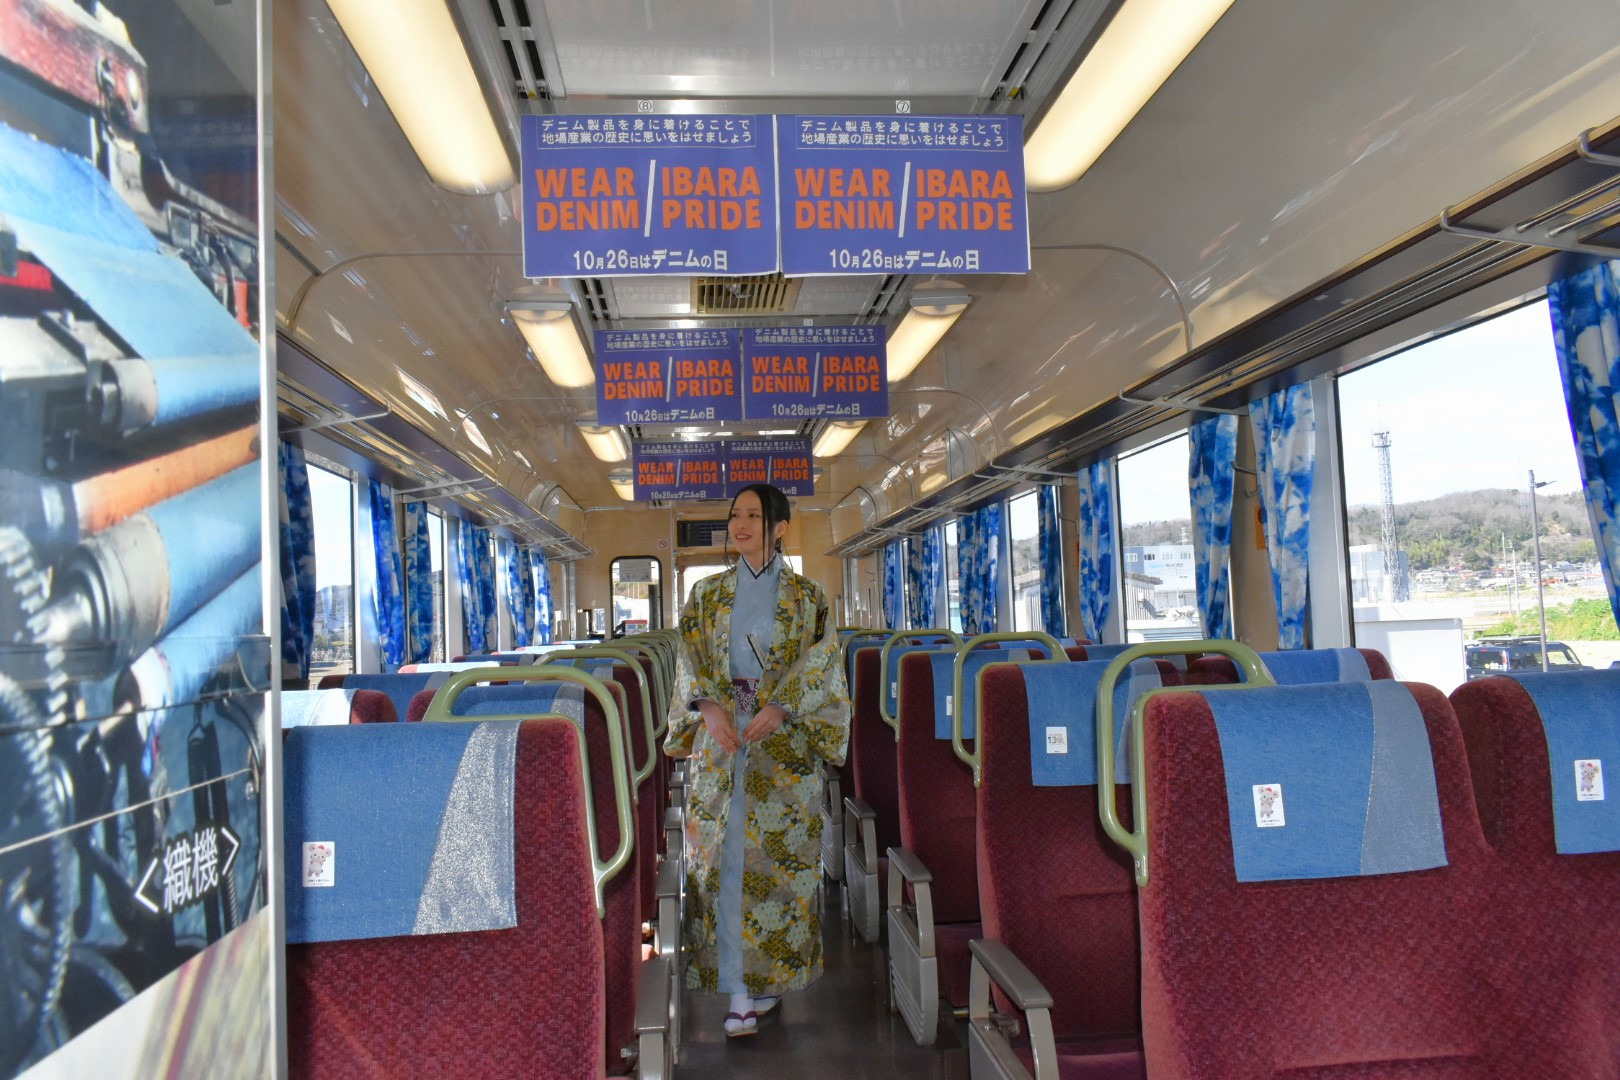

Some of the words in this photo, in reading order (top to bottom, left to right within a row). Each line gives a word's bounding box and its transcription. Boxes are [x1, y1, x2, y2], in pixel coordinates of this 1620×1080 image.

[541, 119, 751, 131] デニム製品を身に着けることで
[801, 120, 1002, 134] デニム製品を身に着けることで
[541, 131, 752, 144] 地場産業の歴史に思いをはせましょう
[801, 133, 1004, 147] 地場産業の歴史に思いをはせましょう
[535, 167, 636, 198] WEAR
[661, 166, 761, 197] IBARA
[795, 168, 891, 198] WEAR
[916, 169, 1013, 199] IBARA
[536, 199, 640, 231] DENIM
[662, 199, 762, 230] PRIDE
[795, 200, 895, 230] DENIM
[916, 201, 1014, 231] PRIDE
[573, 249, 728, 271] 10月26日はデニムの日
[829, 249, 980, 270] 10月26日はデニムの日
[603, 361, 662, 380] WEAR
[676, 359, 734, 378] IBARA
[751, 356, 810, 377] WEAR
[822, 356, 881, 375] IBARA
[604, 379, 664, 400] DENIM
[676, 377, 735, 398] PRIDE
[752, 375, 811, 394] DENIM
[822, 374, 881, 393] PRIDE
[637, 461, 675, 473] WEAR
[682, 461, 719, 472] IBARA
[730, 459, 767, 470] WEAR
[773, 458, 809, 470] IBARA
[638, 473, 676, 486] DENIM
[682, 472, 719, 485] PRIDE
[730, 470, 767, 482] DENIM
[773, 469, 810, 481] PRIDE
